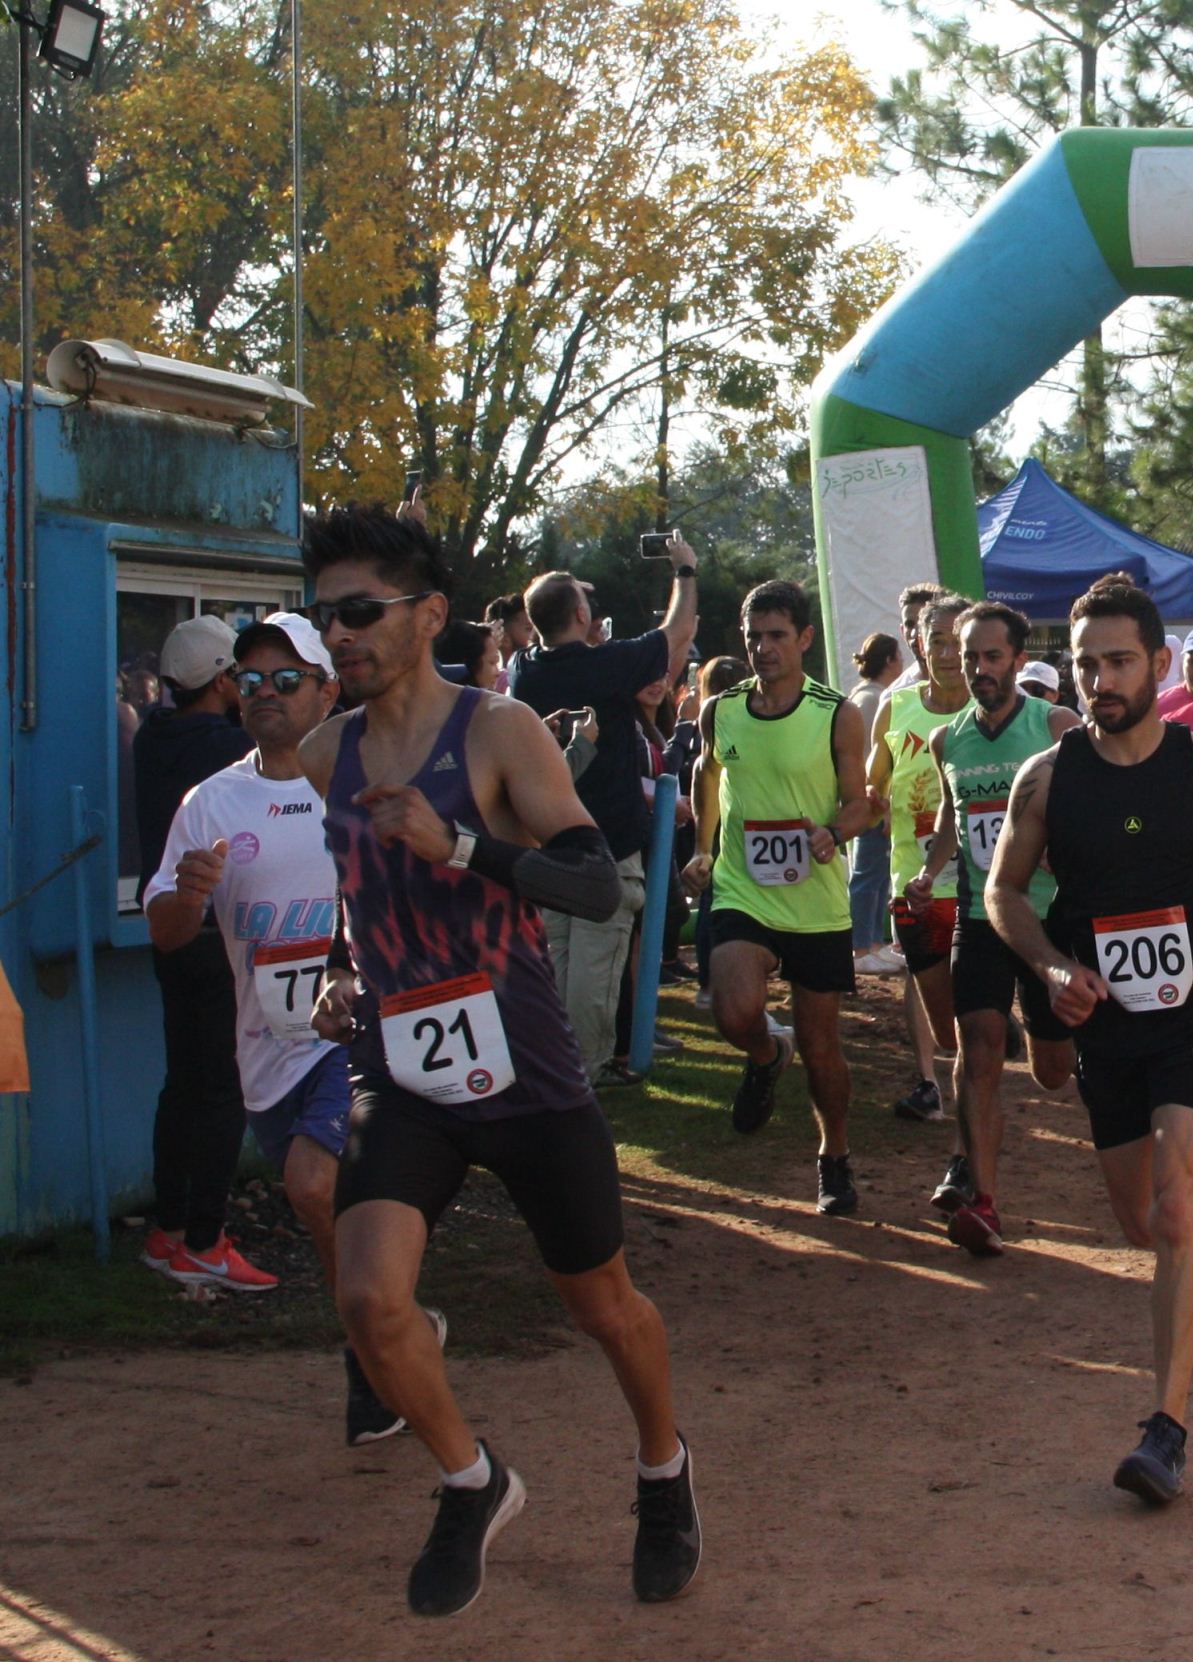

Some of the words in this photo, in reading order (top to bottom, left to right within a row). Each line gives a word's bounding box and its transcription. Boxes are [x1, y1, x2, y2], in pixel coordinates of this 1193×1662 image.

[987, 591, 1034, 600] CHIVILCOY
[281, 802, 313, 816] JEMA
[752, 835, 803, 865] 201
[233, 901, 277, 941] LA
[1105, 933, 1185, 983] 206
[413, 1008, 479, 1072] 21
